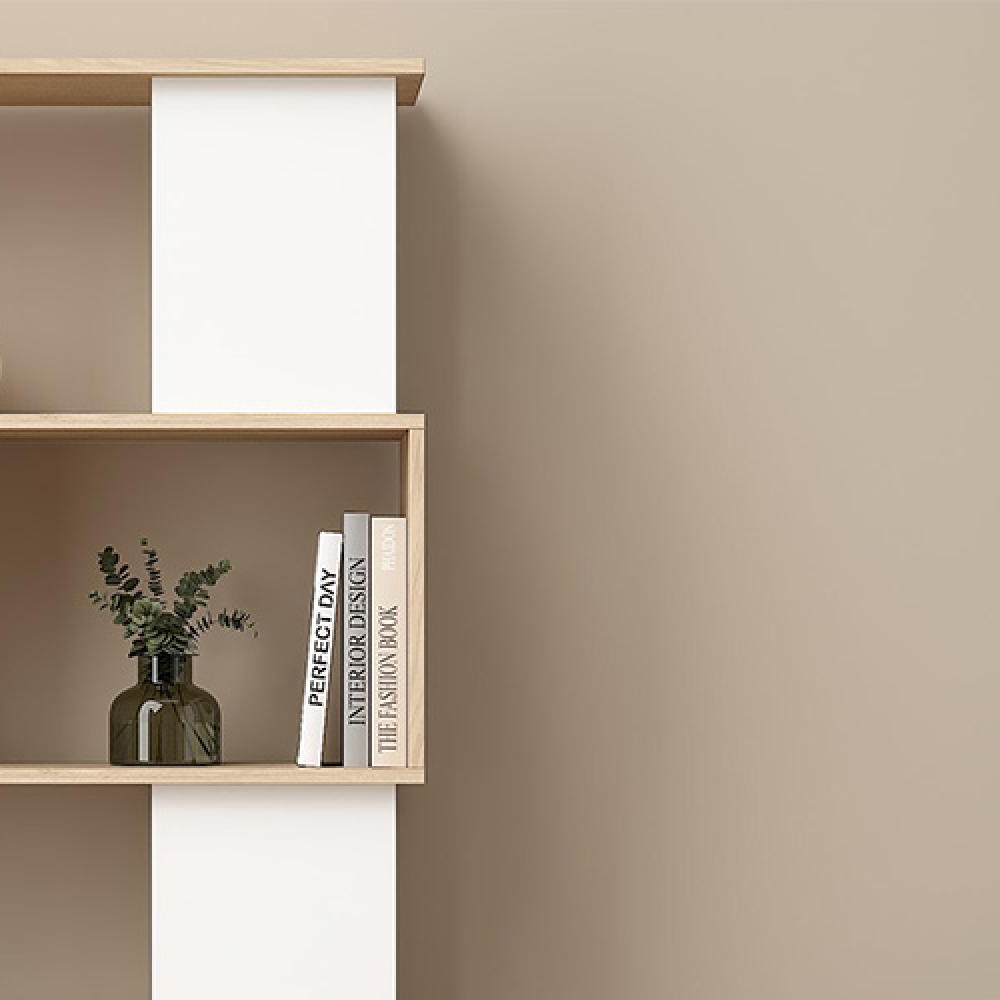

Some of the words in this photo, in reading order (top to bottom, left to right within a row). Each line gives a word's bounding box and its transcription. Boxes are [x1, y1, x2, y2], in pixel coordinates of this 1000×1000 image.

[318, 568, 337, 609] DAY
[348, 557, 367, 629] DESIGN
[308, 612, 332, 707] PERFECT
[378, 605, 397, 649] BOOK
[348, 633, 367, 725] INTERIOR
[378, 653, 397, 719] FASHION
[378, 721, 397, 754] THE
